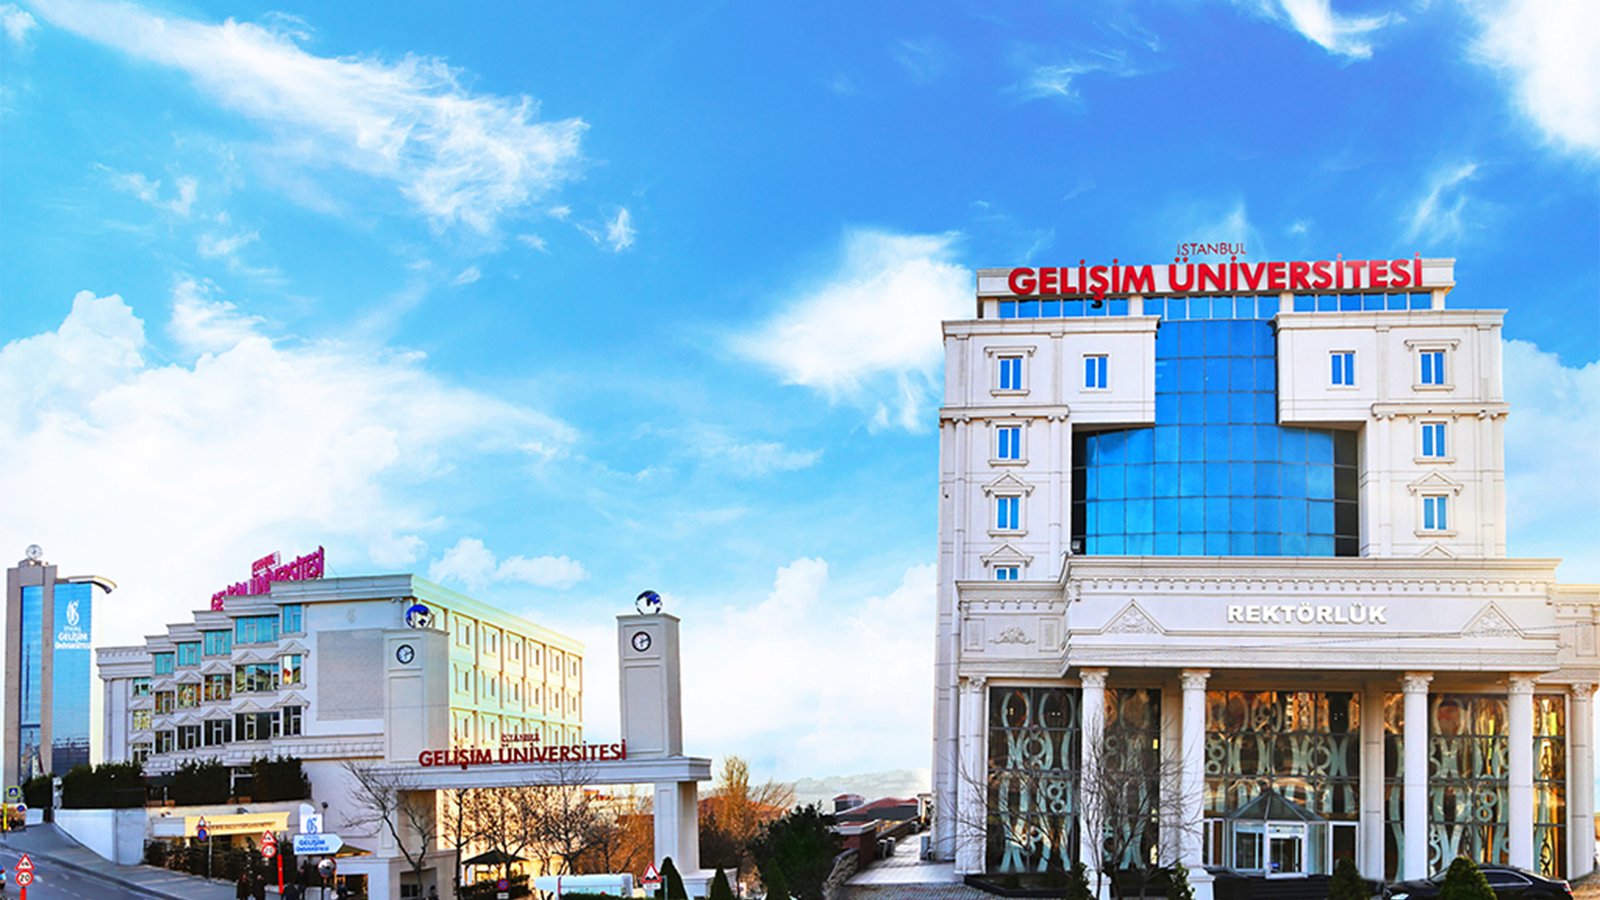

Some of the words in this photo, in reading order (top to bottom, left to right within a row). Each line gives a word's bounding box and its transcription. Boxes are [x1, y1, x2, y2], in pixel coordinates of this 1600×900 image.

[1008, 258, 1156, 308] GELİŞİM
[1168, 252, 1422, 292] ÜNİVERSİTESİ
[1227, 602, 1387, 624] REKTÖRLÜK
[418, 745, 493, 770] GELİŞİM
[499, 739, 626, 764] ÜNİVERSİTESİ
